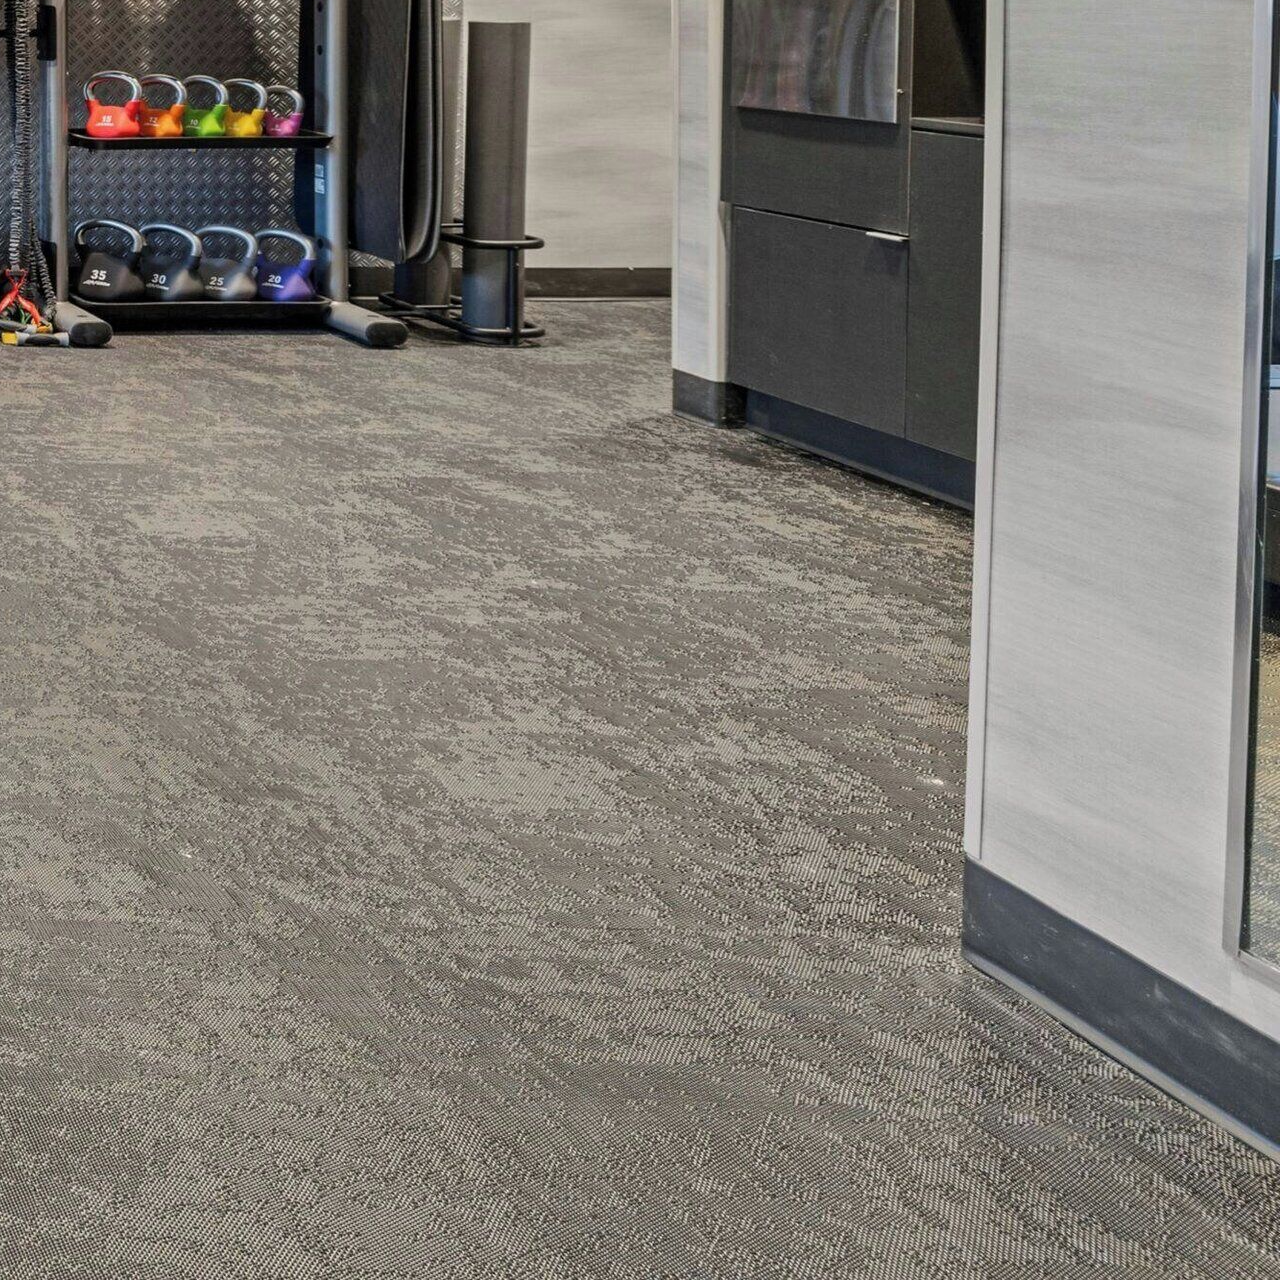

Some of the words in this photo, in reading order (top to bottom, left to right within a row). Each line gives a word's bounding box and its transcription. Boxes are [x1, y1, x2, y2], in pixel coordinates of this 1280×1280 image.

[90, 269, 107, 280] 35
[151, 273, 167, 284] 30
[268, 274, 281, 284] 20
[209, 276, 224, 286] 25
